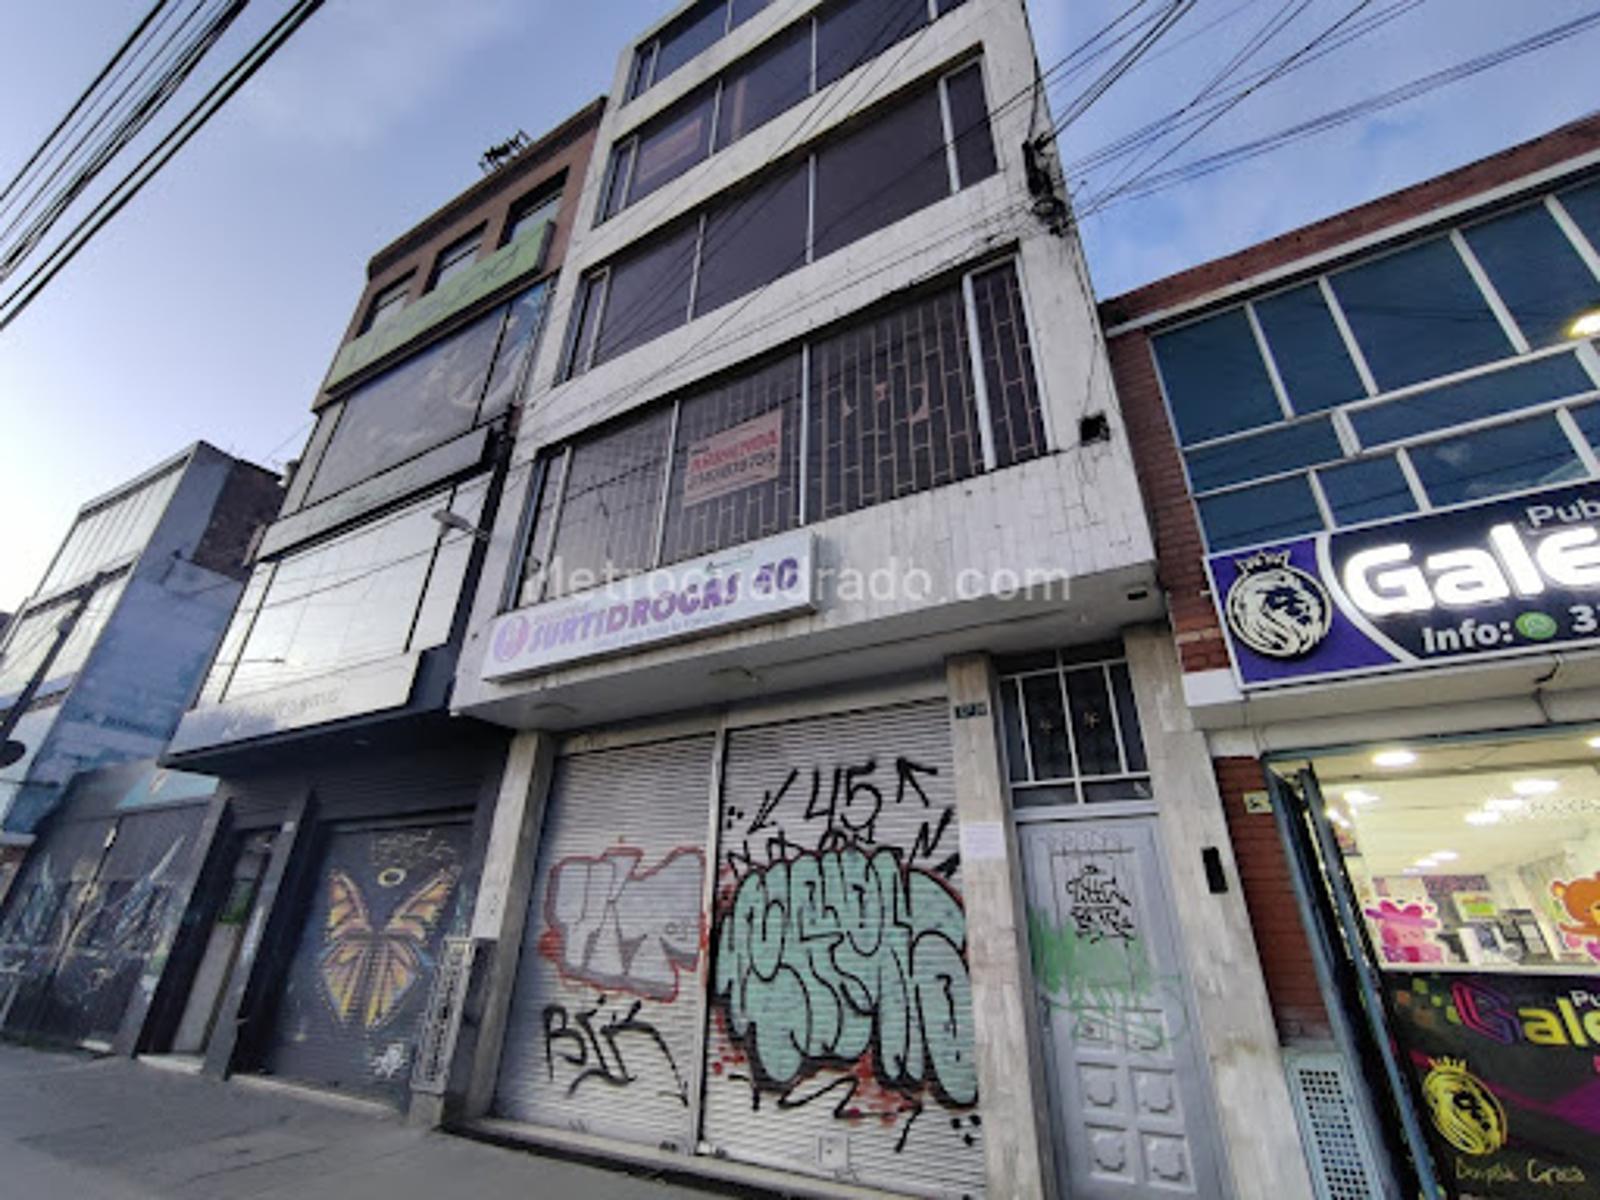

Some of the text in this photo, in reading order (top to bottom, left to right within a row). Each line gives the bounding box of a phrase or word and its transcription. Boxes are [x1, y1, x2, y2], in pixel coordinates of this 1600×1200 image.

[1344, 522, 1600, 616] Gale
[1423, 604, 1600, 653] Info: 3
